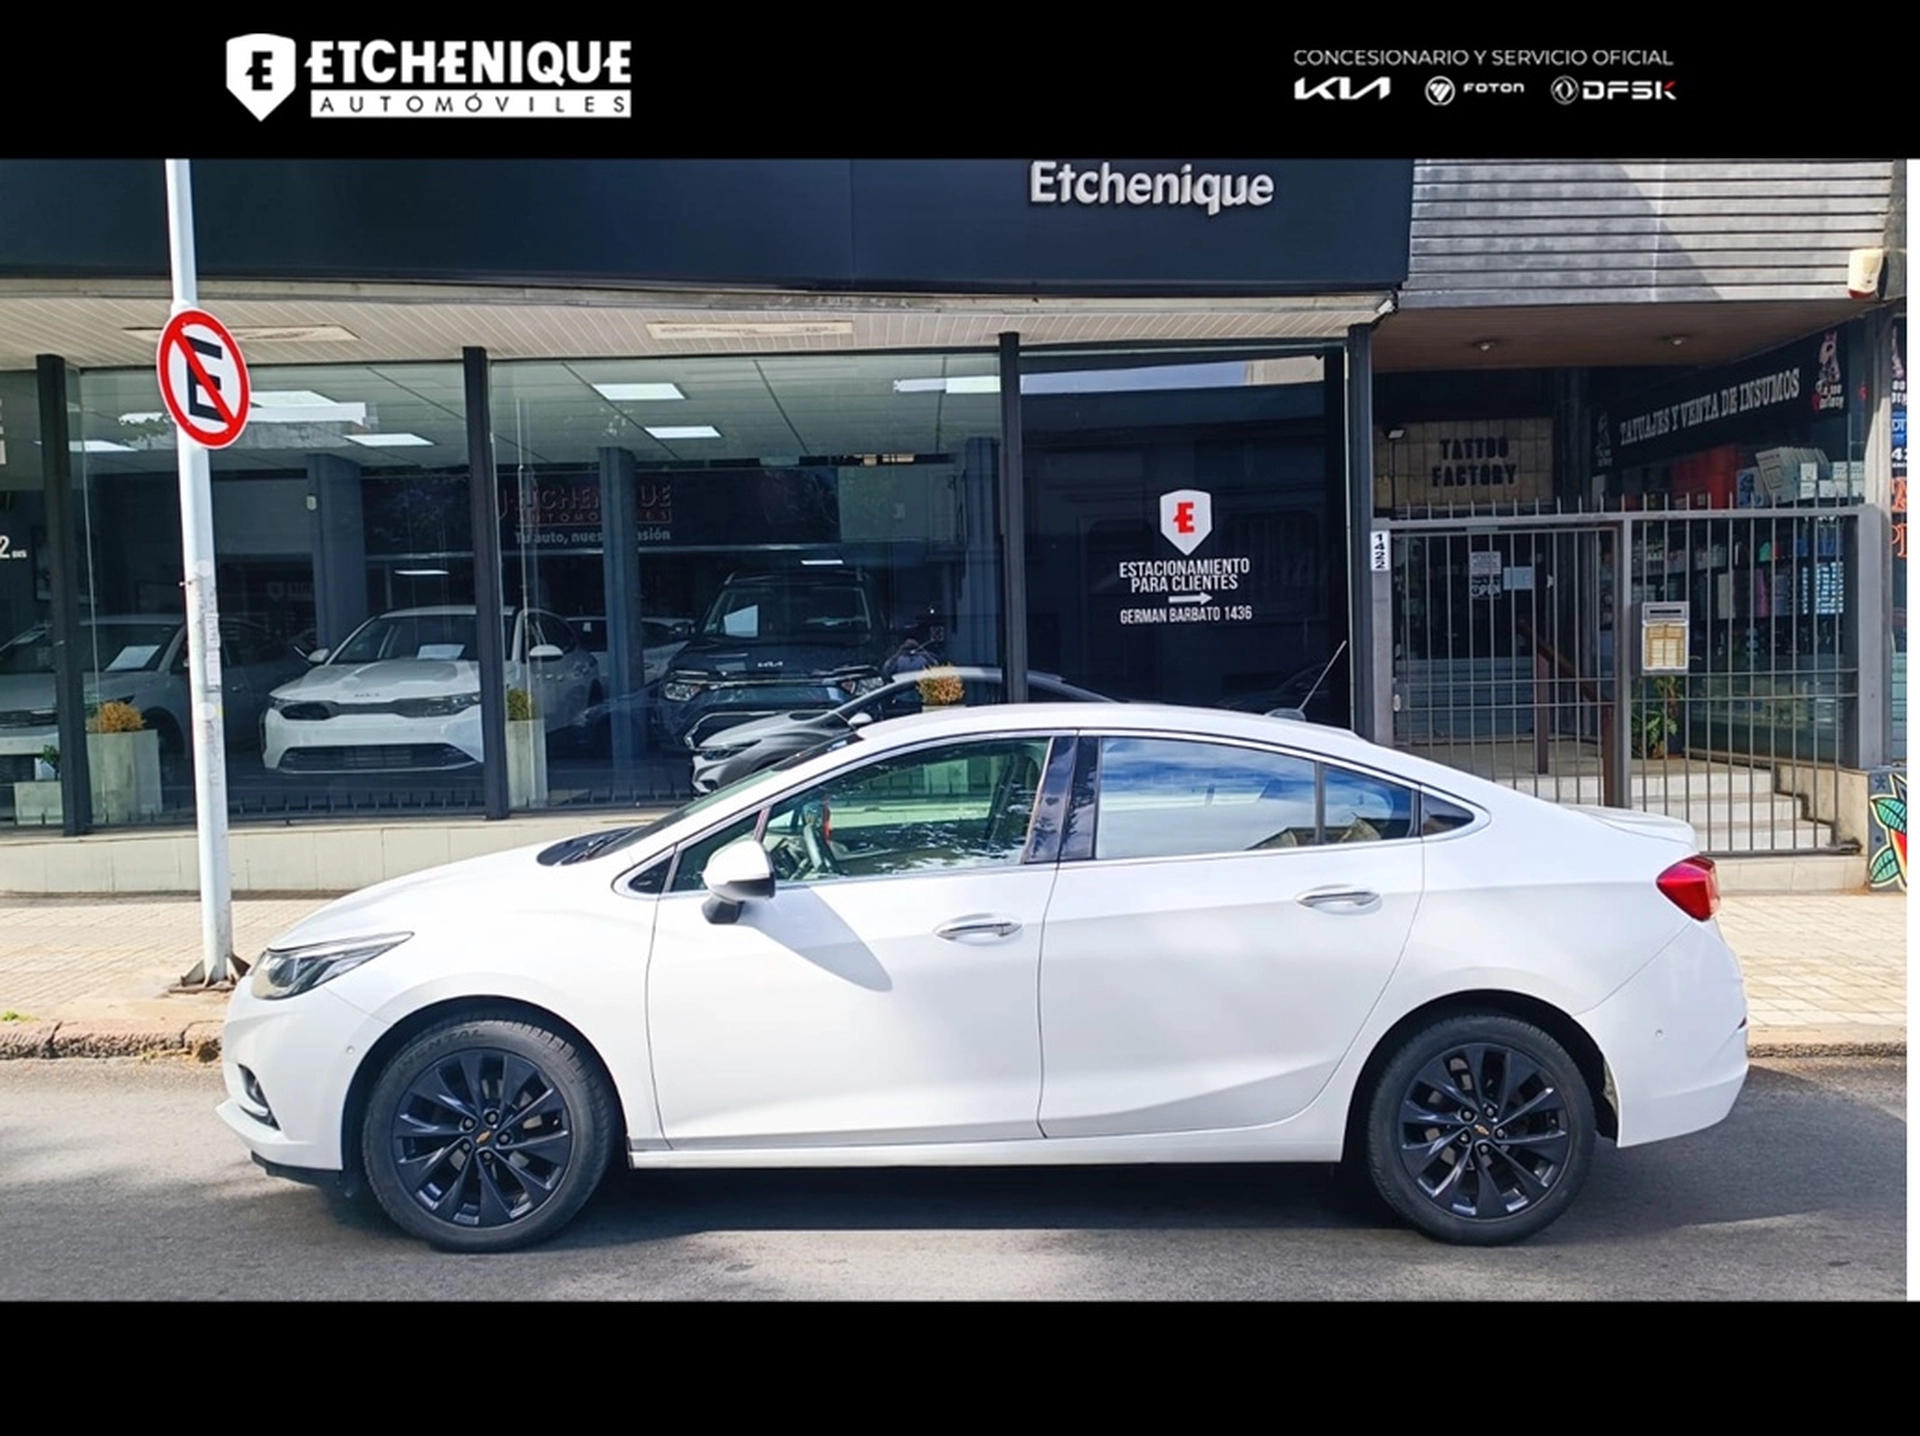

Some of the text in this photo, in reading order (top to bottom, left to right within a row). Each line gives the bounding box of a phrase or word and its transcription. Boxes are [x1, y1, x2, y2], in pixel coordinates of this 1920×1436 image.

[1030, 160, 1275, 216] Etchenique
[185, 335, 226, 424] E
[1620, 367, 1801, 446] TATUAJES Y VENTA DE INSUMOS
[1440, 436, 1509, 460] TATTOO
[1432, 464, 1517, 487] FACTORY
[1172, 501, 1195, 534] E
[534, 529, 569, 546] auto,
[571, 530, 603, 544] nues
[1374, 533, 1386, 569] 1422
[1119, 557, 1250, 578] ESTACIONAMIENTO
[1131, 574, 1239, 594] PARA CLIENTES
[1120, 605, 1253, 625] GERMAN BARBATO 1436
